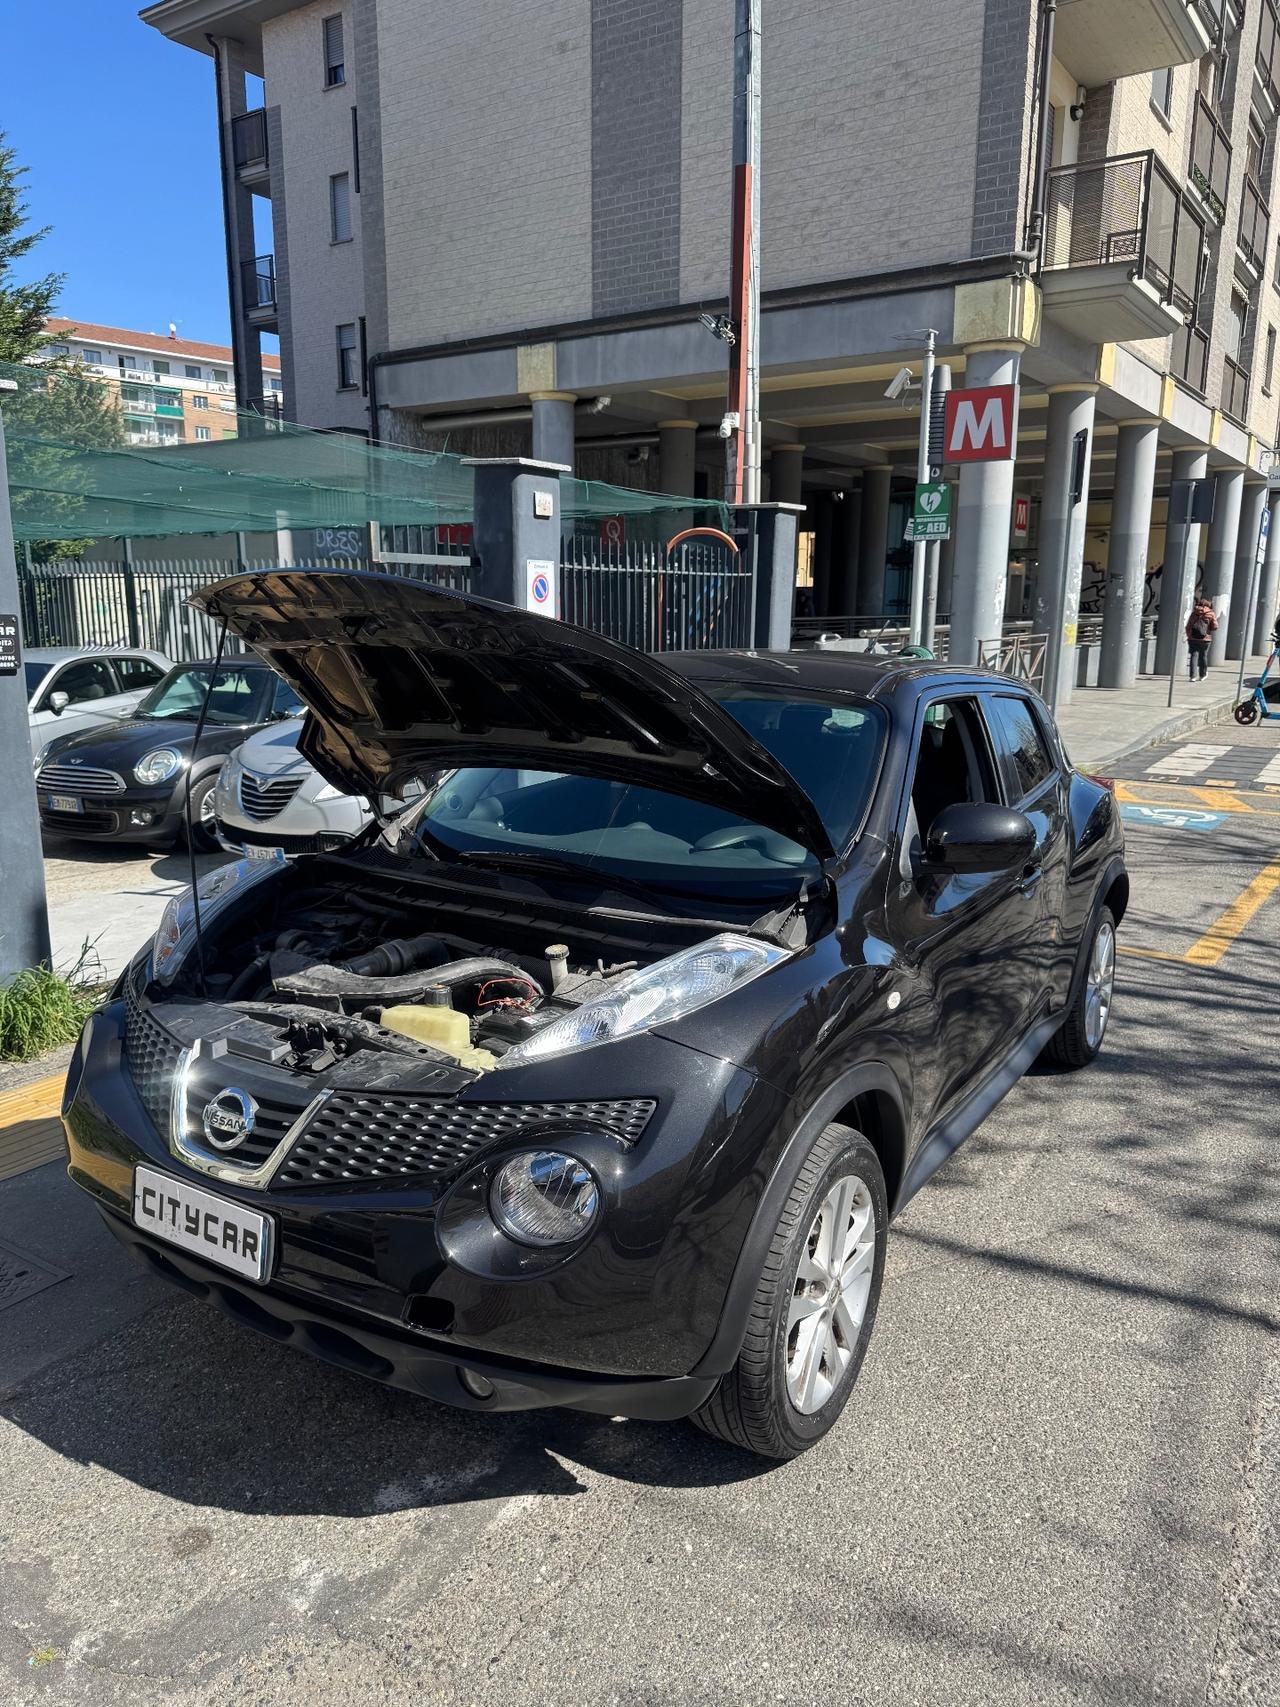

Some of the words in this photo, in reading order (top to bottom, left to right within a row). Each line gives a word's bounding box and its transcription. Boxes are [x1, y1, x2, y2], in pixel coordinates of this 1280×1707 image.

[950, 398, 1006, 451] M
[1017, 503, 1026, 524] M
[1262, 511, 1269, 532] P
[927, 522, 947, 533] AED
[203, 1106, 247, 1131] NISSAN
[142, 1186, 259, 1262] CITYCAR
